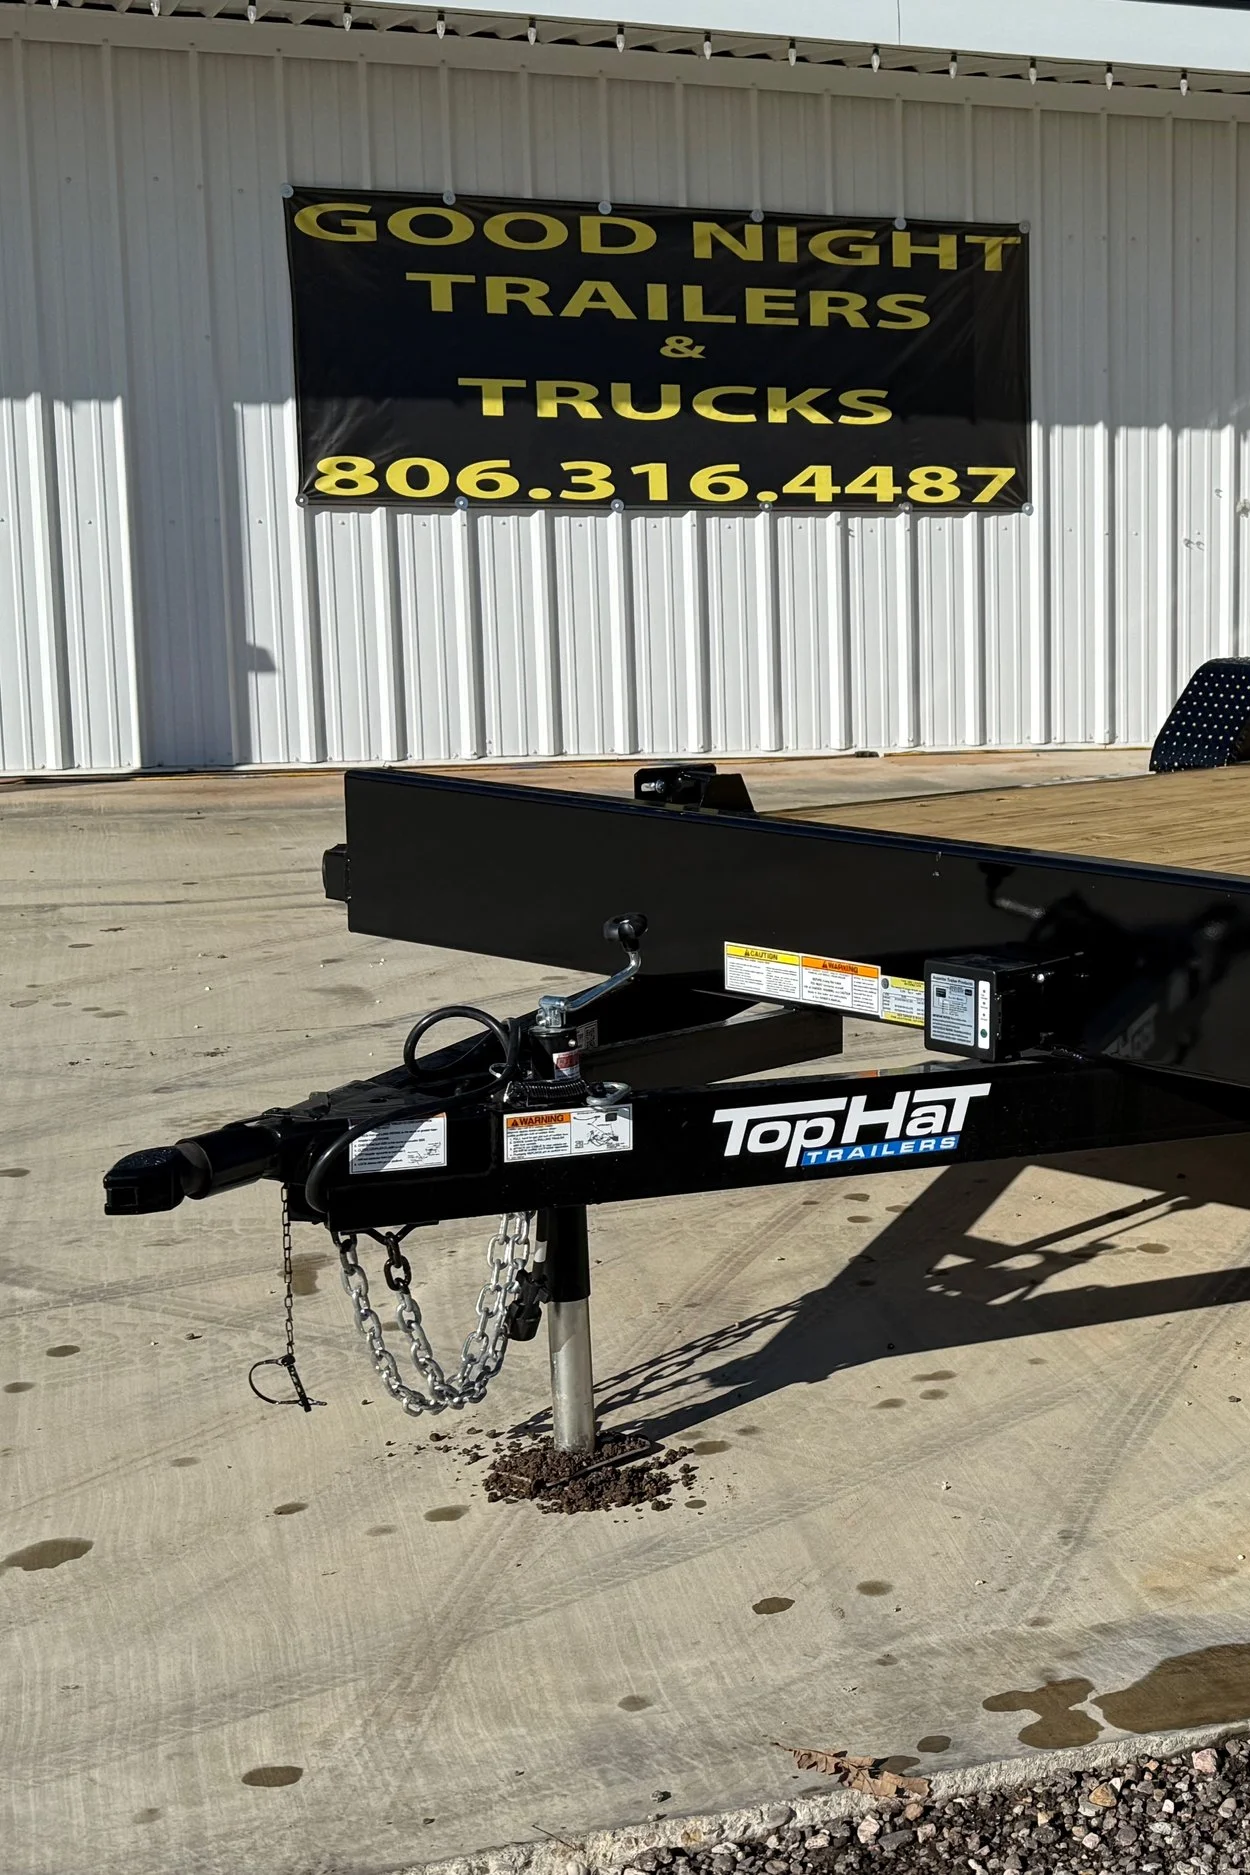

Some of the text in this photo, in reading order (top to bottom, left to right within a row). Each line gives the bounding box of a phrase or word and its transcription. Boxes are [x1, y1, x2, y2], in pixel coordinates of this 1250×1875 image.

[294, 203, 1021, 272] GOOD NIGHT
[405, 272, 931, 330] TRAILERS
[659, 335, 706, 359] &
[457, 377, 893, 425] TRUCKS
[314, 455, 1016, 503] 806.316.4487
[750, 949, 778, 961] CAUTION
[828, 960, 859, 974] WARNING
[520, 1114, 564, 1127] WARNING
[807, 1136, 957, 1165] TRAILERS
